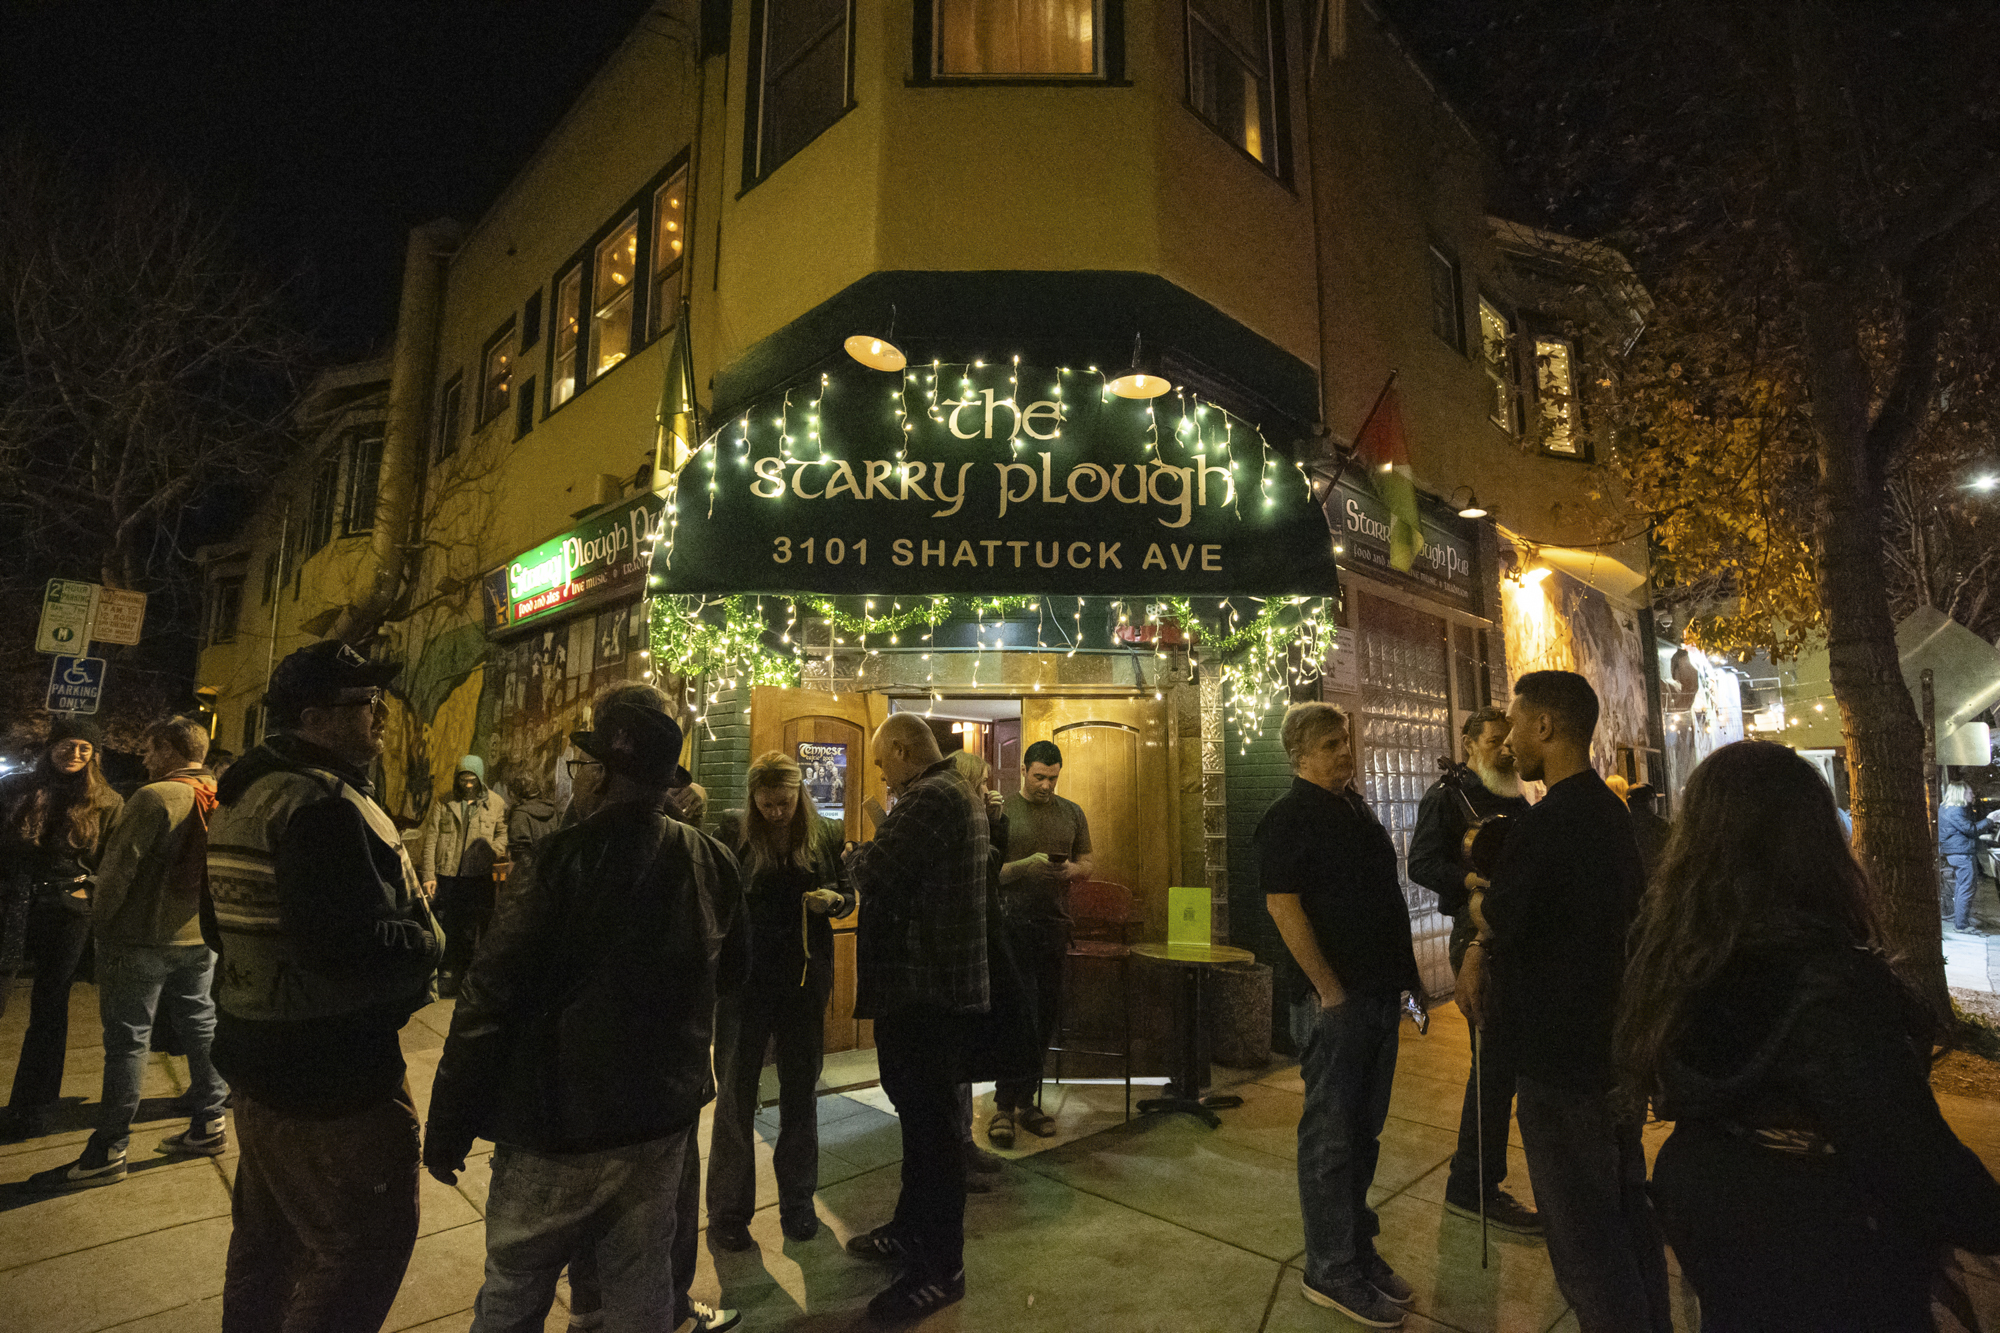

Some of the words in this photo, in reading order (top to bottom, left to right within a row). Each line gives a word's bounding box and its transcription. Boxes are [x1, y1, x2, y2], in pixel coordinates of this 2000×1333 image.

[942, 388, 1067, 440] the
[630, 505, 666, 561] Pu
[1346, 498, 1391, 544] Starr
[1419, 543, 1446, 569] ough
[772, 536, 868, 565] 3101
[892, 538, 1123, 569] SHATTUCK
[1142, 544, 1223, 571] AVE
[50, 582, 62, 598] 2
[518, 599, 533, 617] food
[534, 595, 546, 610] and
[546, 590, 560, 605] ales
[57, 627, 69, 641] M
[51, 683, 98, 698] PARKING
[59, 696, 88, 709] ONLY
[798, 742, 845, 758] Tempest
